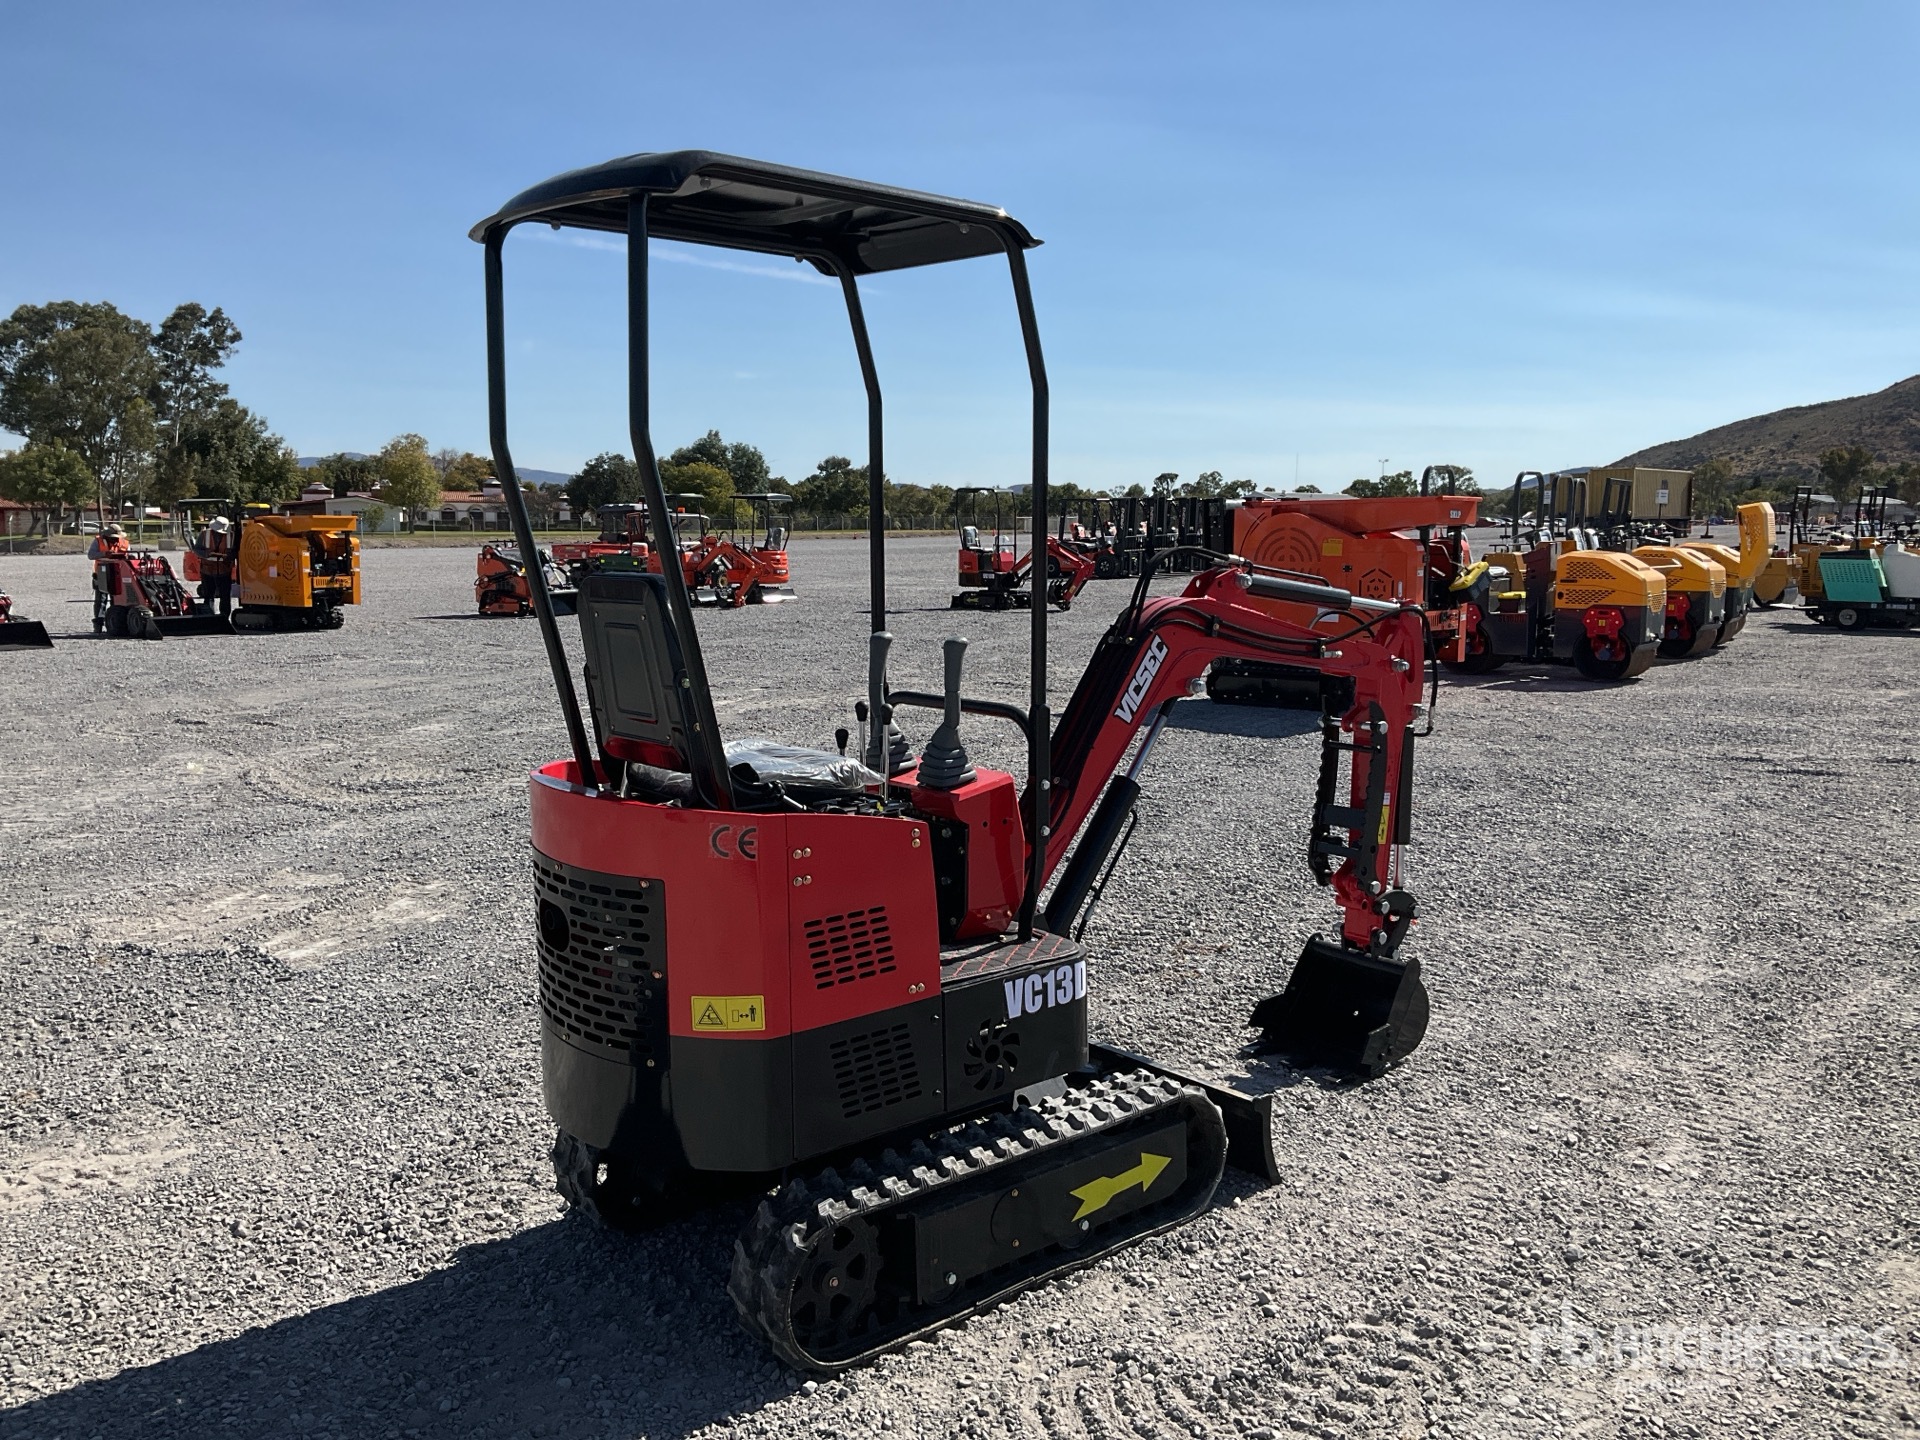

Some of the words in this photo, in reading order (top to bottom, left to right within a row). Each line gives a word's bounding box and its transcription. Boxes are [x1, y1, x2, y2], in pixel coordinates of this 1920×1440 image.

[1114, 634, 1169, 724] VICSEC
[711, 825, 757, 860] CE
[1004, 960, 1087, 1019] VC13D
